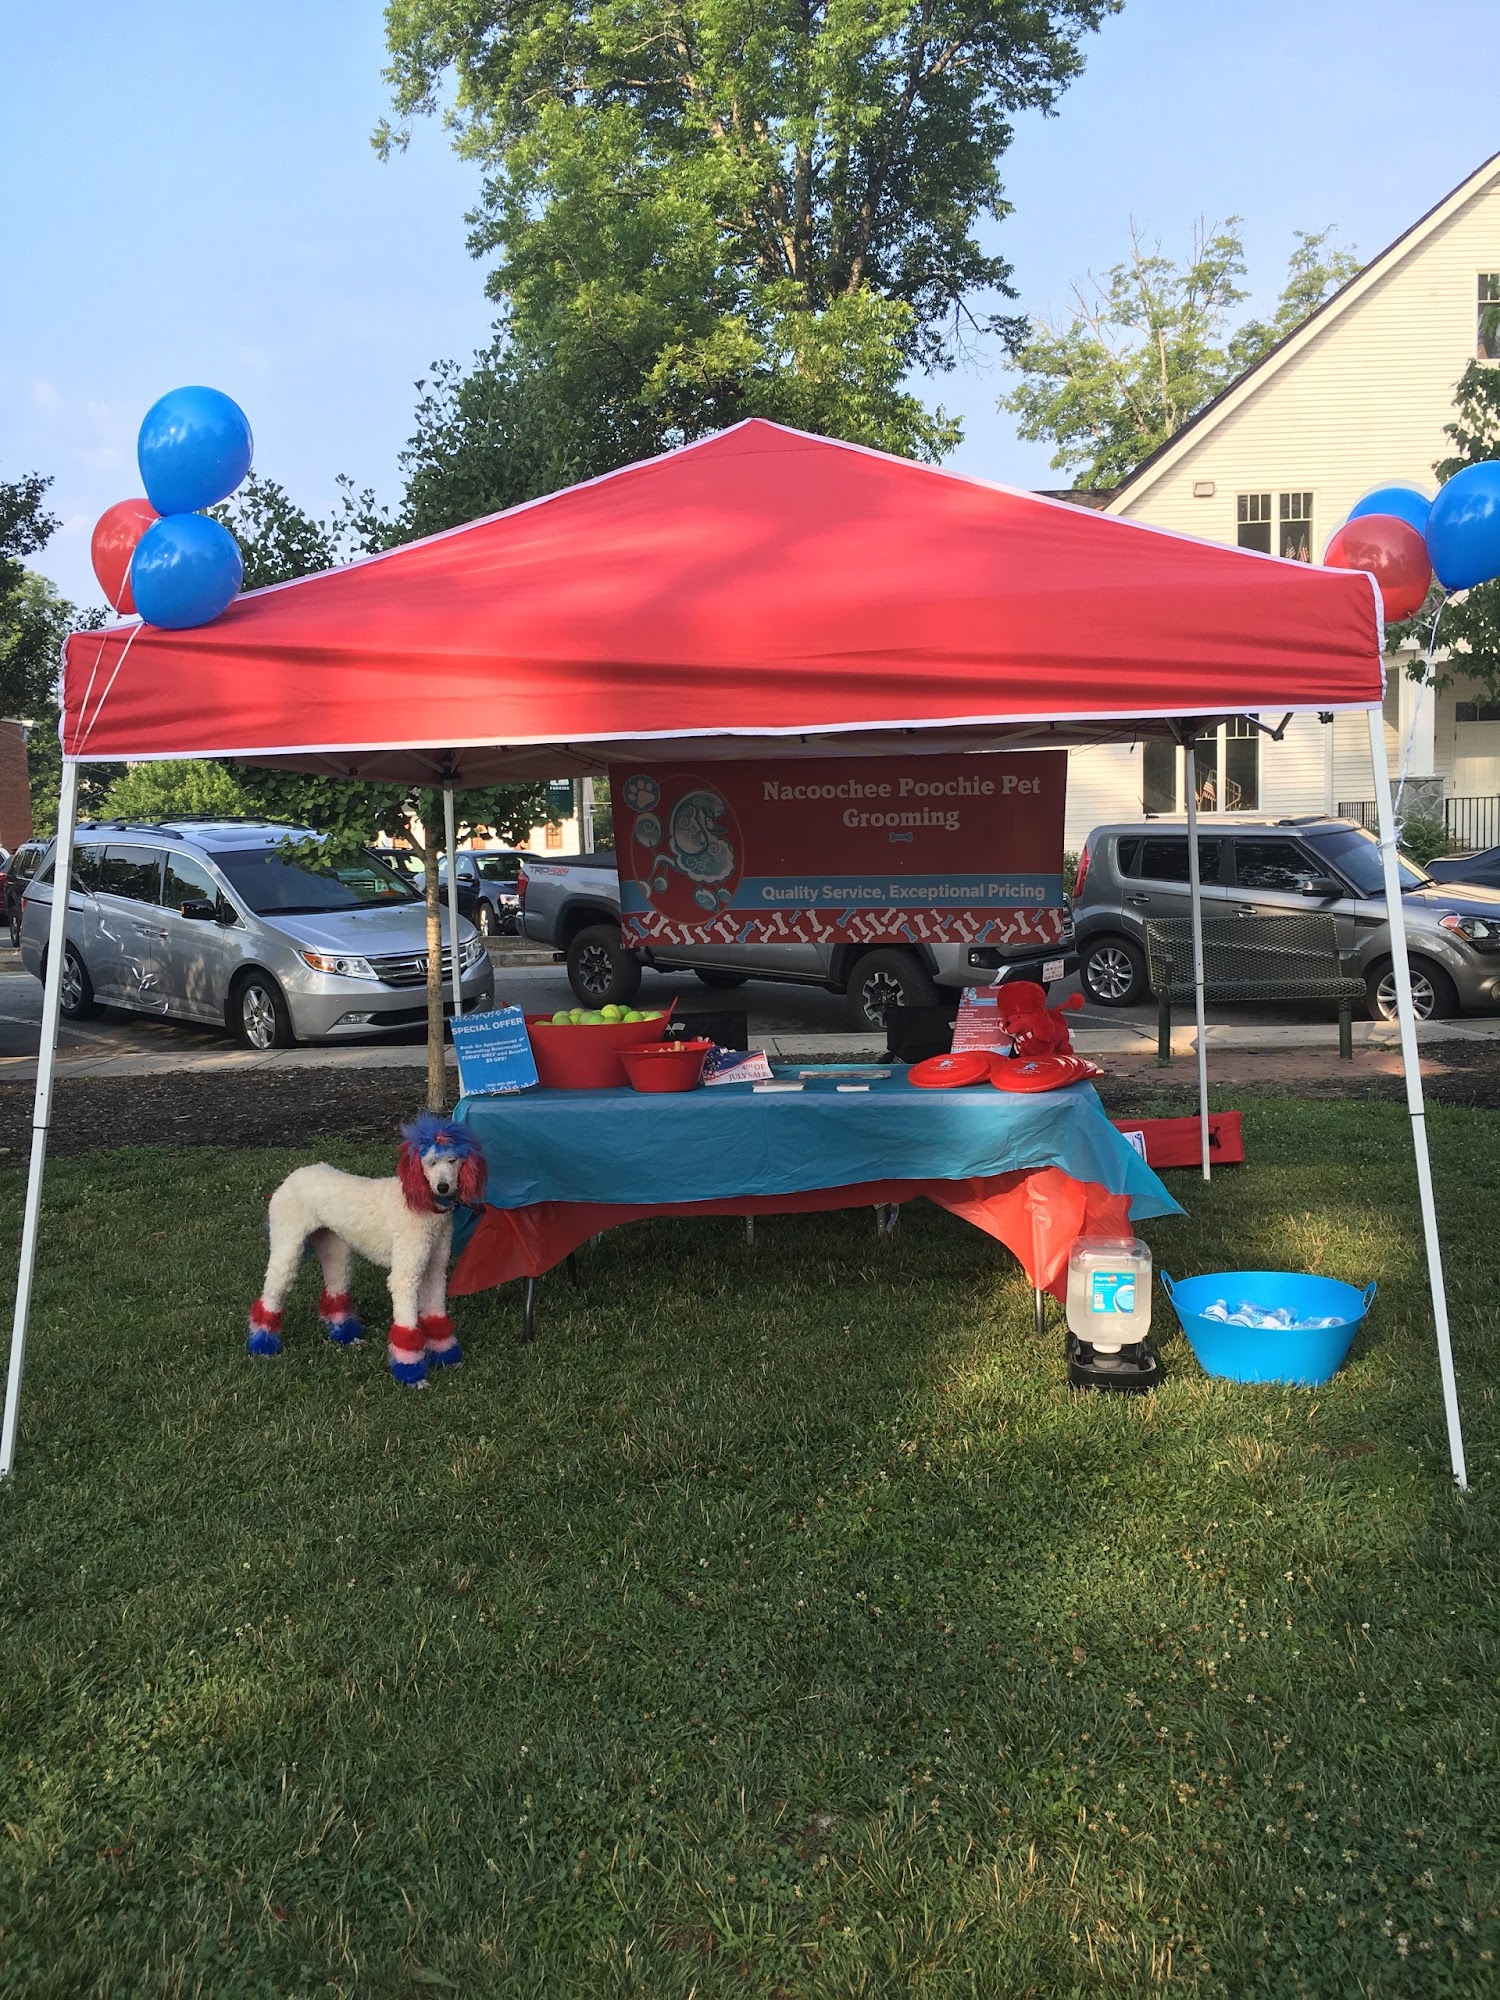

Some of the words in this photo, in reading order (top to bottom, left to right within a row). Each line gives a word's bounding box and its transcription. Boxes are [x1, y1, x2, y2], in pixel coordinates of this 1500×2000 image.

[763, 779, 892, 801] Nacoochee
[898, 776, 995, 797] Poochie
[1001, 775, 1041, 795] Pet
[842, 807, 960, 831] Grooming
[762, 886, 819, 901] Quality
[822, 885, 886, 901] Service,
[889, 884, 984, 901] Exceptional
[988, 884, 1046, 901] Pricing
[451, 1024, 491, 1035] SPECIAL
[492, 1017, 523, 1029] OFFER
[729, 1073, 747, 1081] JULY
